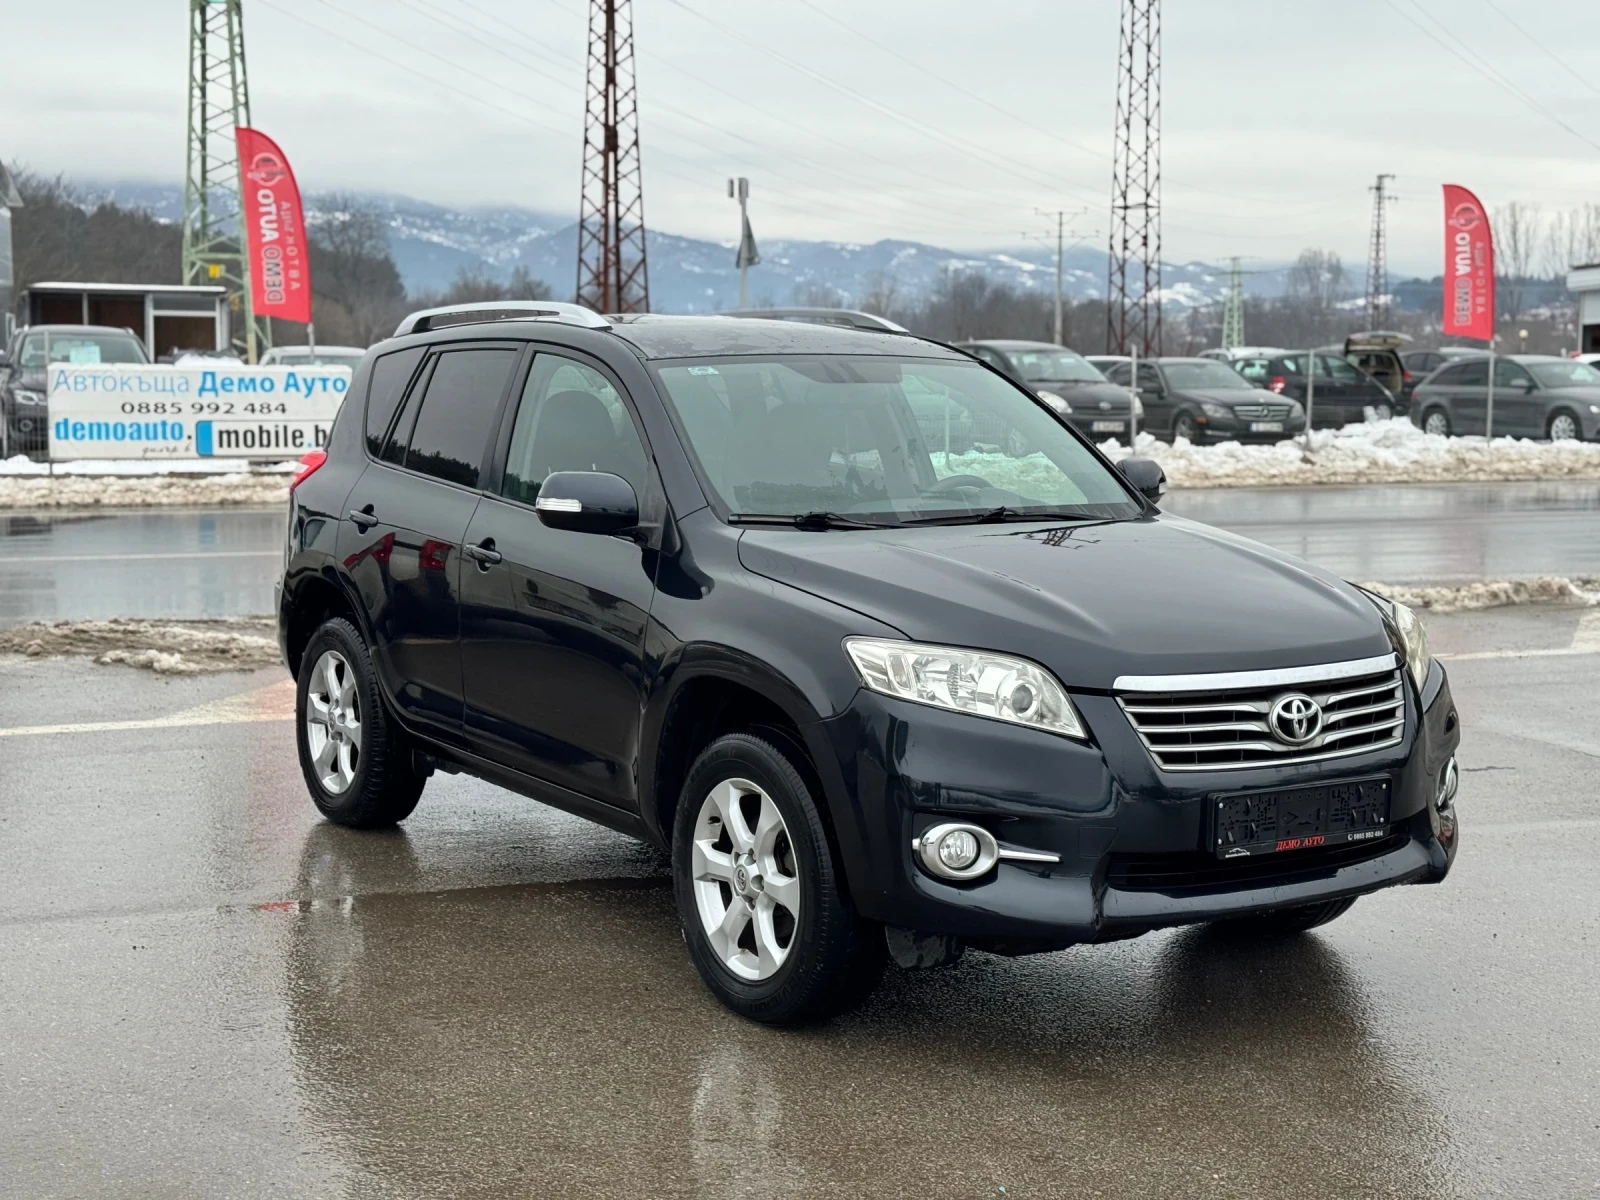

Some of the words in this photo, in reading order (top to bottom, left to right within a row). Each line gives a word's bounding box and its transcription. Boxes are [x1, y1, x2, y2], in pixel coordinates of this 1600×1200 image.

[53, 370, 190, 395] Автокъща
[198, 371, 275, 397] Демо
[283, 372, 346, 398] Ауто
[121, 402, 182, 415] 0885
[191, 402, 236, 415] 992
[244, 402, 286, 415] 484
[54, 418, 192, 441] demoauto.
[1276, 839, 1300, 851] ДЕМО
[1302, 836, 1325, 846] АУТО
